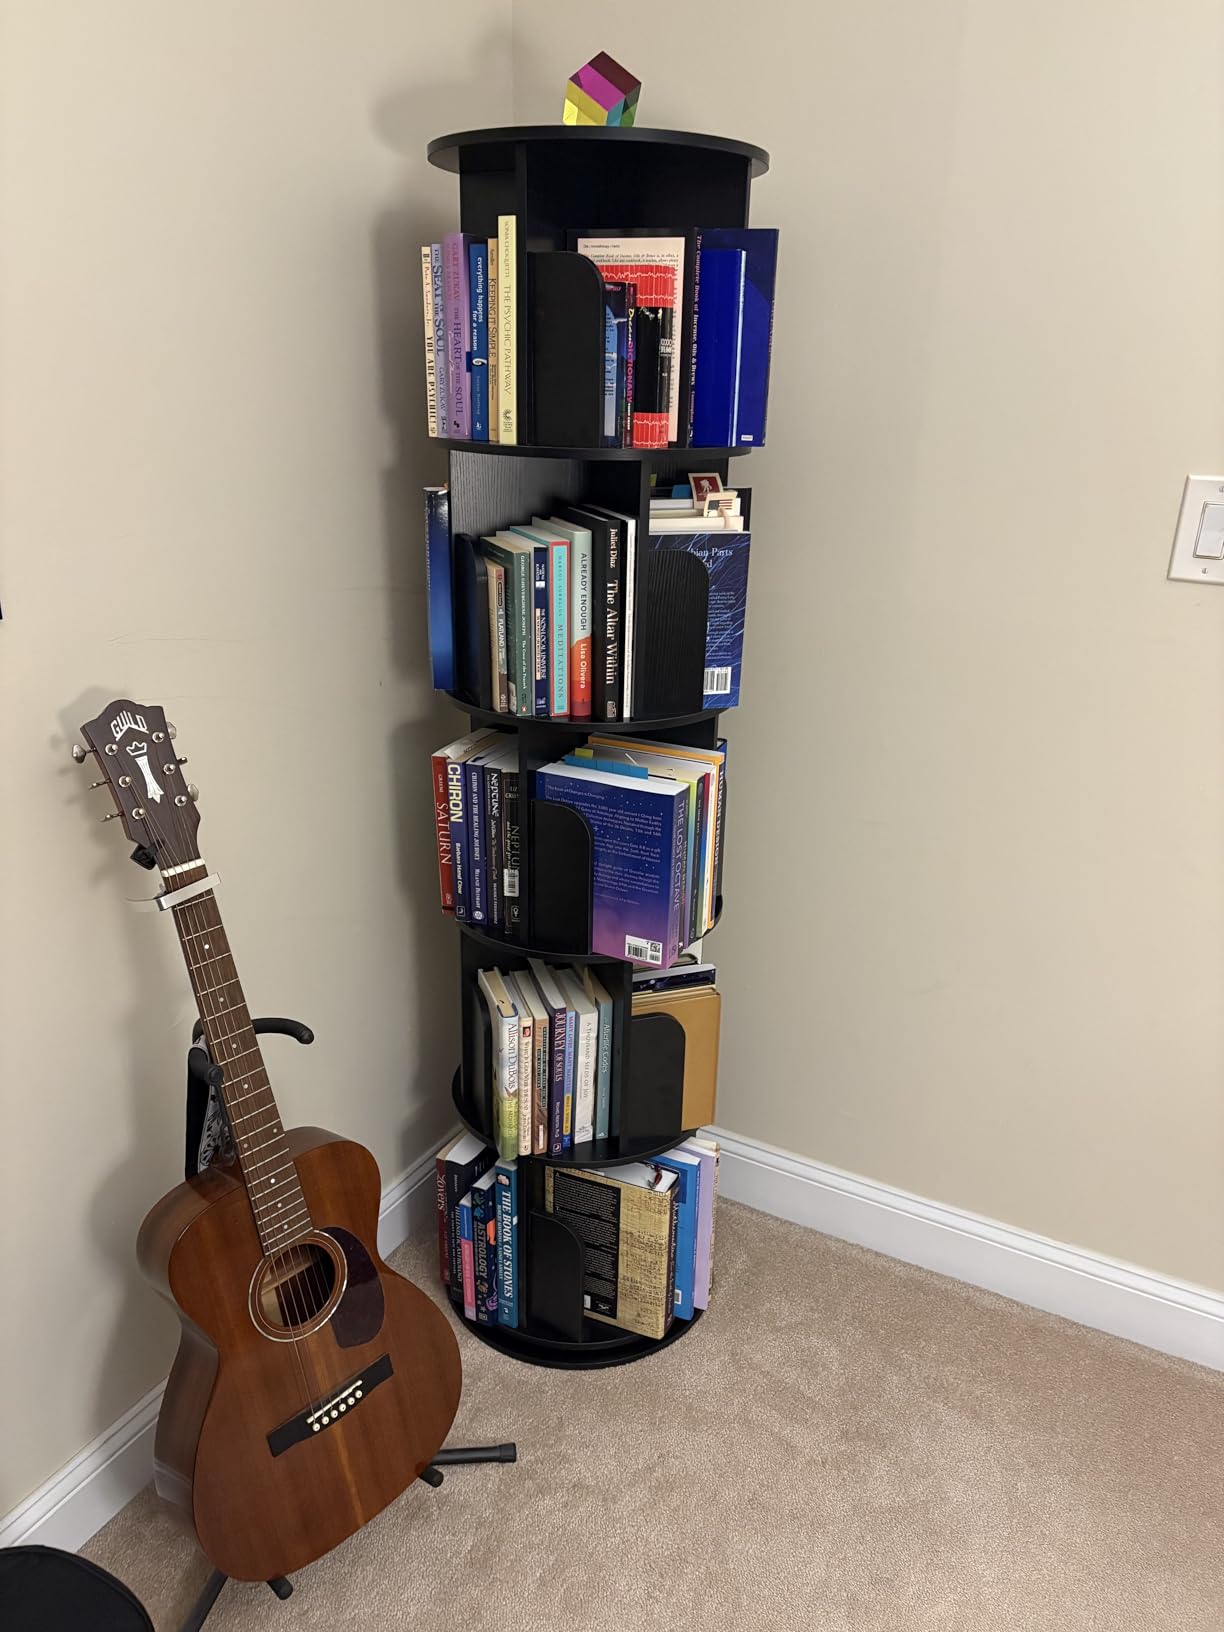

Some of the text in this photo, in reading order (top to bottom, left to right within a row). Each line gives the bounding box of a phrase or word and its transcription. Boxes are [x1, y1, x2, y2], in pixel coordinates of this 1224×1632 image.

[432, 264, 444, 300] SEAT
[476, 256, 485, 322] everything happens
[488, 278, 497, 316] KEEPING
[503, 284, 512, 303] THE
[488, 317, 496, 326] IT
[503, 304, 512, 347] PSYCHIC
[694, 303, 700, 312] of
[434, 318, 446, 357] SOUL
[454, 321, 462, 363] HEART
[489, 326, 498, 358] SIMPLE
[504, 348, 512, 395] PATHWAY
[626, 340, 634, 403] DICTIONARY
[429, 381, 437, 424] PSYCHIC!
[455, 387, 464, 416] SOUL
[711, 547, 734, 557] Parts
[580, 552, 588, 631] ALREADY ENOUGH
[605, 528, 619, 685] Juliet Diaz The Altar Within
[579, 643, 588, 689] Lisa Olivera
[110, 710, 149, 742] GUILD
[447, 763, 464, 823] CHIRON
[677, 799, 685, 827] THE
[716, 770, 724, 817] HUMAN
[436, 802, 452, 865] SATURN
[676, 828, 684, 860] LOST
[673, 861, 682, 912] OCTAVE
[507, 1023, 519, 1054] Allison
[554, 1012, 566, 1082] JOURNEY OF SOULS
[601, 1024, 611, 1073] Afterlife Codes
[508, 1056, 518, 1090] DuBois
[436, 1173, 447, 1211] Lovers
[477, 1222, 488, 1279] ASTROLOGY
[501, 1191, 513, 1298] THE BOOK OF STONES
